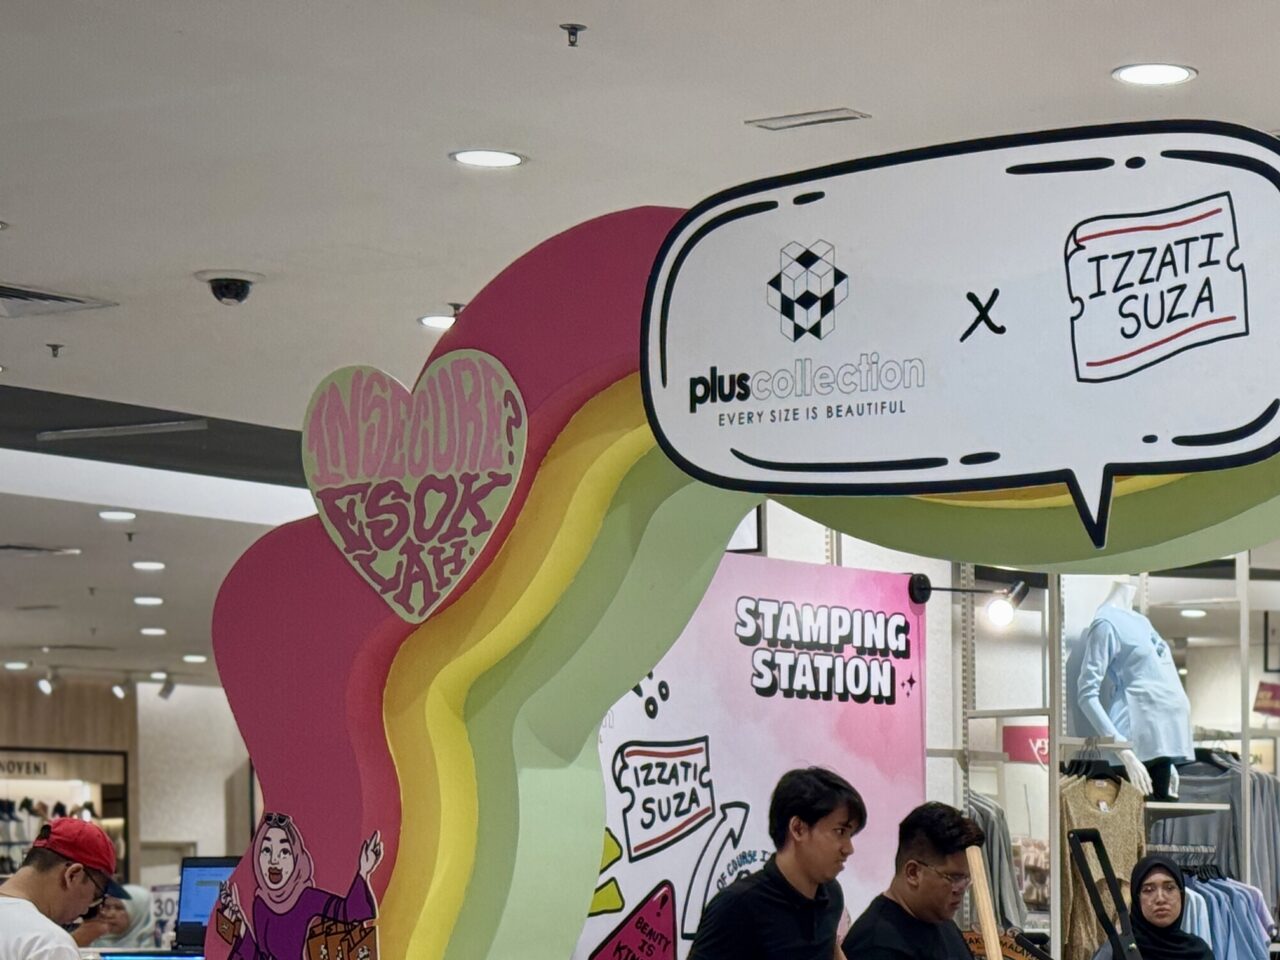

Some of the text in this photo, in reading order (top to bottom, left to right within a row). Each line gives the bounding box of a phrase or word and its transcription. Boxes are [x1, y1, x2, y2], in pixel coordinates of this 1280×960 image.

[1087, 232, 1224, 299] IZZATI
[1119, 276, 1215, 341] SUZA
[718, 400, 906, 426] EVERY SIZE IS BEAUTIFUL
[316, 471, 513, 552] ESOK
[734, 596, 910, 659] STAMPING
[750, 648, 896, 705] STATION
[633, 760, 698, 788] IZZATI
[640, 786, 701, 830] SUZA
[727, 850, 757, 876] COURSE
[154, 898, 178, 918] 30
[634, 916, 672, 952] BEAUTY
[637, 939, 656, 957] IS
